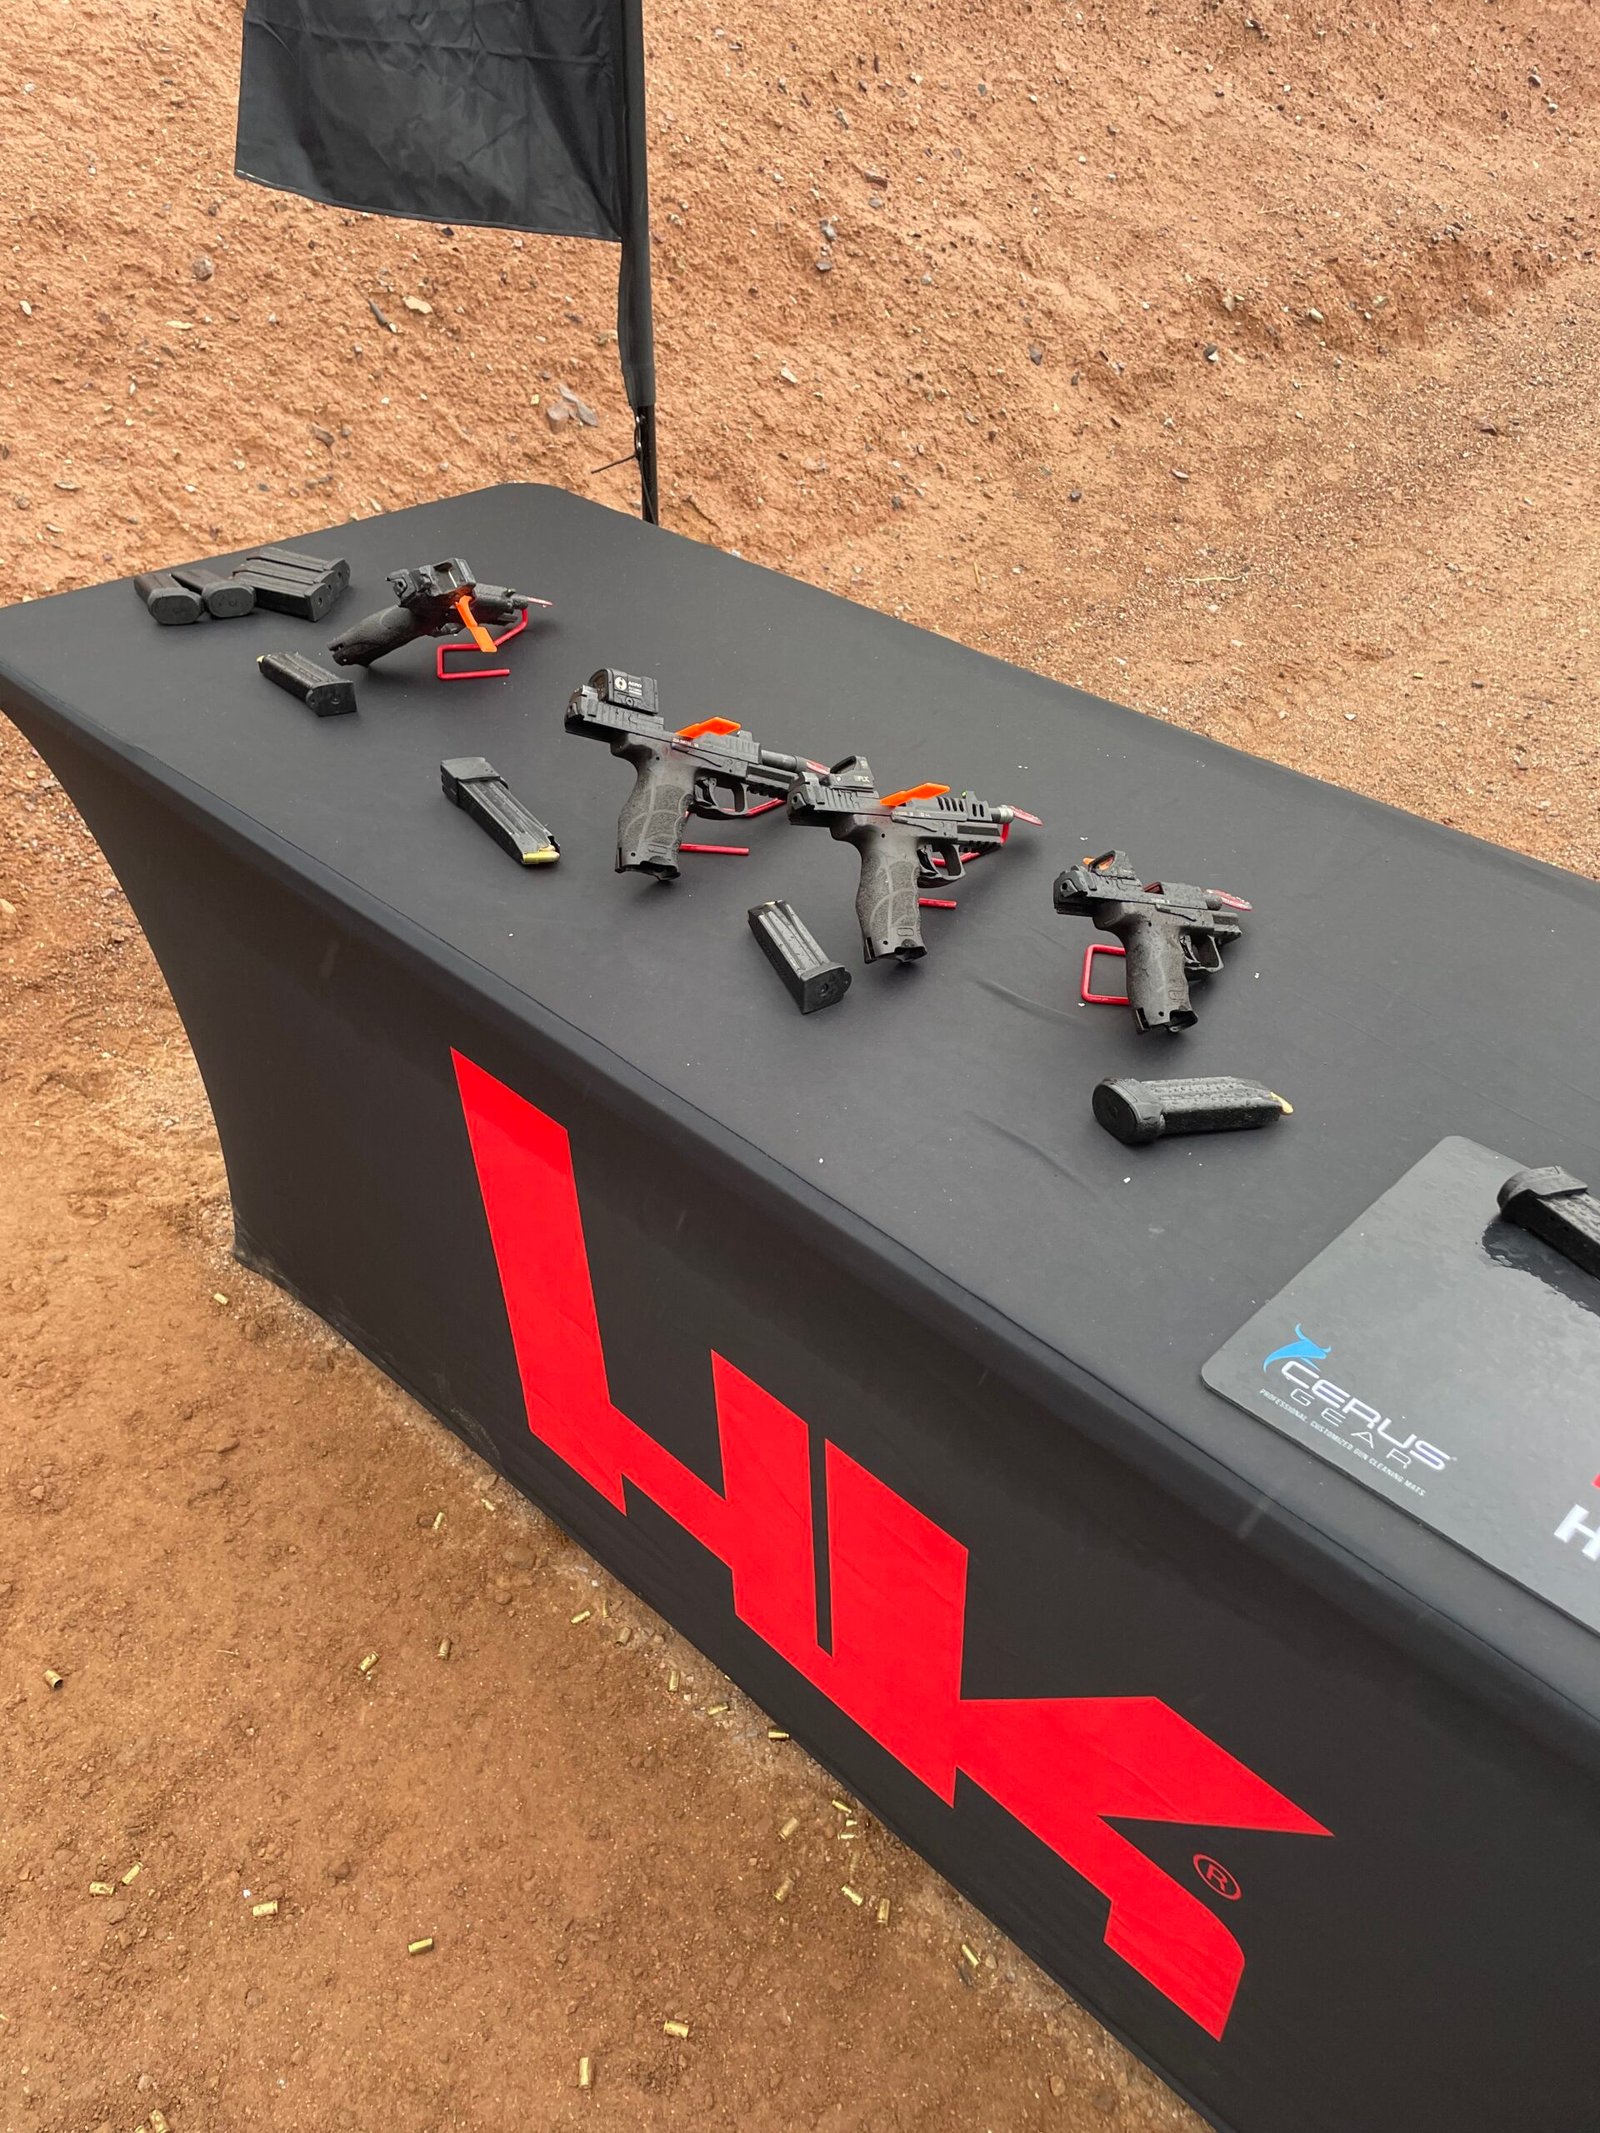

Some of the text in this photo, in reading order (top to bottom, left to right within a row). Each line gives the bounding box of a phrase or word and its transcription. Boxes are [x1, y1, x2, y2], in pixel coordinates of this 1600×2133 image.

[1281, 1360, 1450, 1471] CERUS
[1290, 1388, 1411, 1469] GEAR
[1310, 1421, 1353, 1450] CUSTOMIZED
[1353, 1448, 1369, 1460] GUN
[1369, 1458, 1405, 1483] CLEANING
[1404, 1480, 1426, 1496] MATS
